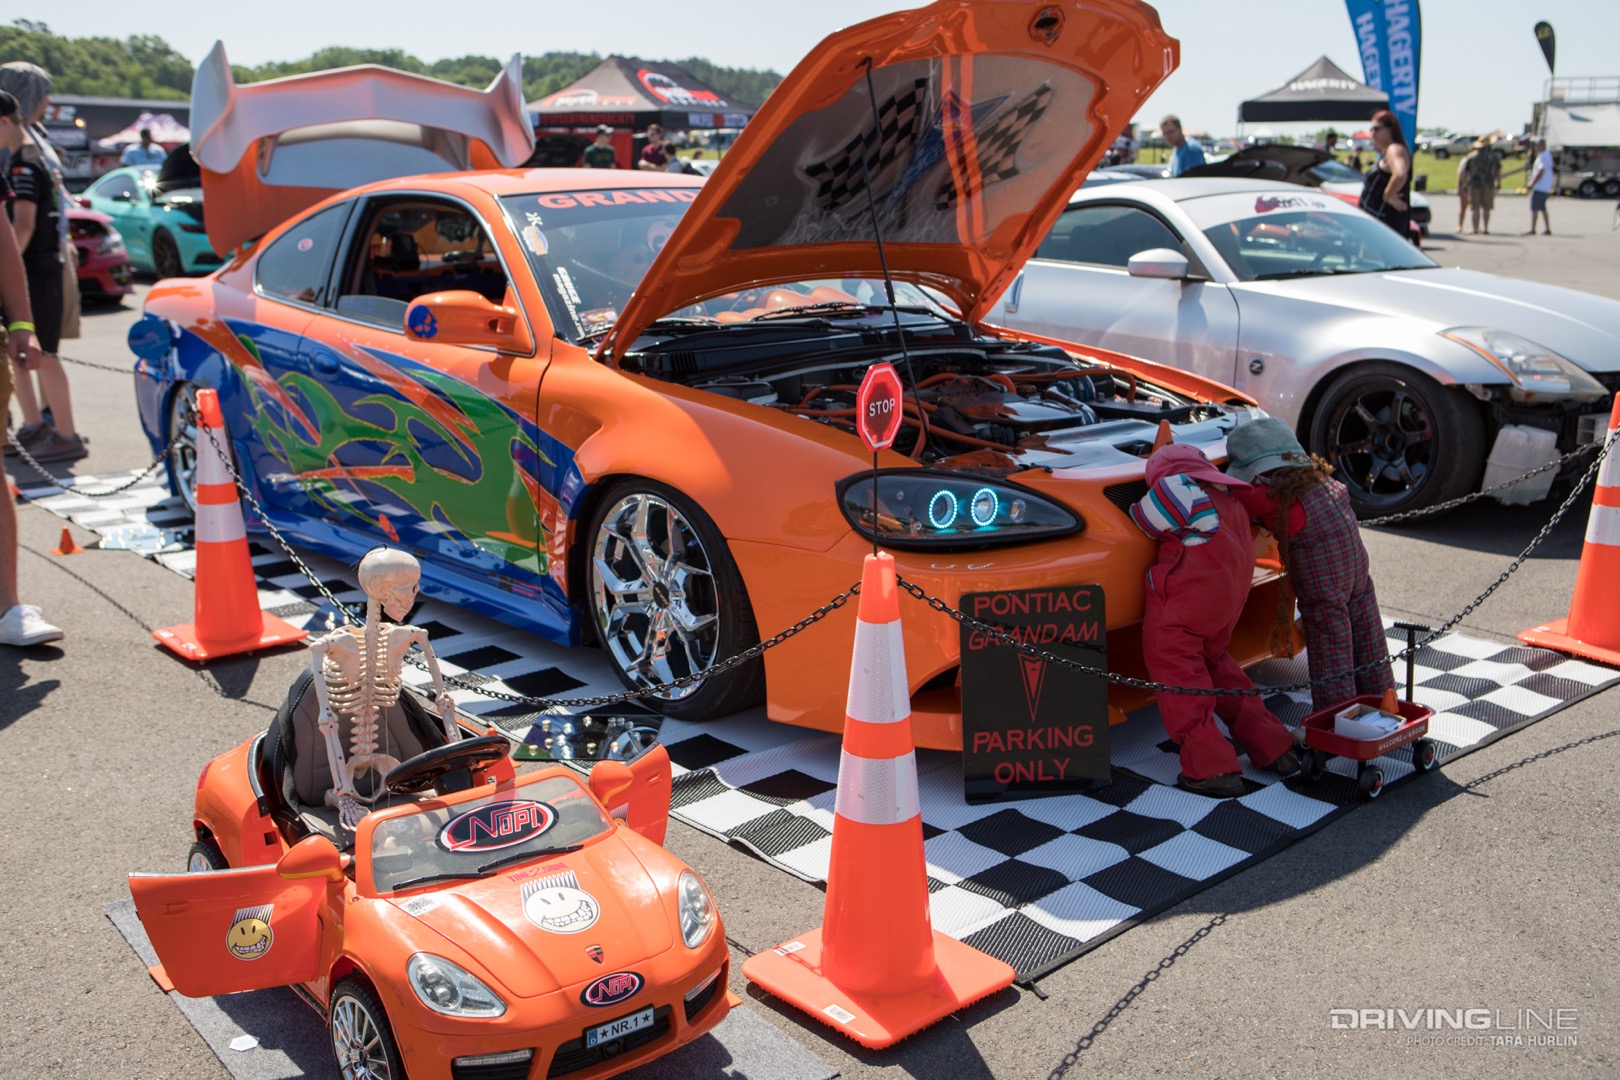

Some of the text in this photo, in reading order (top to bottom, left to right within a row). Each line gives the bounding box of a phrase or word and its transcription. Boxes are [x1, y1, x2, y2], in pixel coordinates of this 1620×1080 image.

[1385, 0, 1415, 116] HAGERTY
[538, 190, 698, 208] GRAND
[869, 397, 896, 417] STOP
[973, 590, 1092, 618] PONTIAC
[972, 725, 1094, 754] PARKING
[994, 758, 1070, 785] ONLY
[507, 871, 529, 883] TIME
[541, 861, 568, 874] SHINE
[611, 1016, 638, 1036] NR.1
